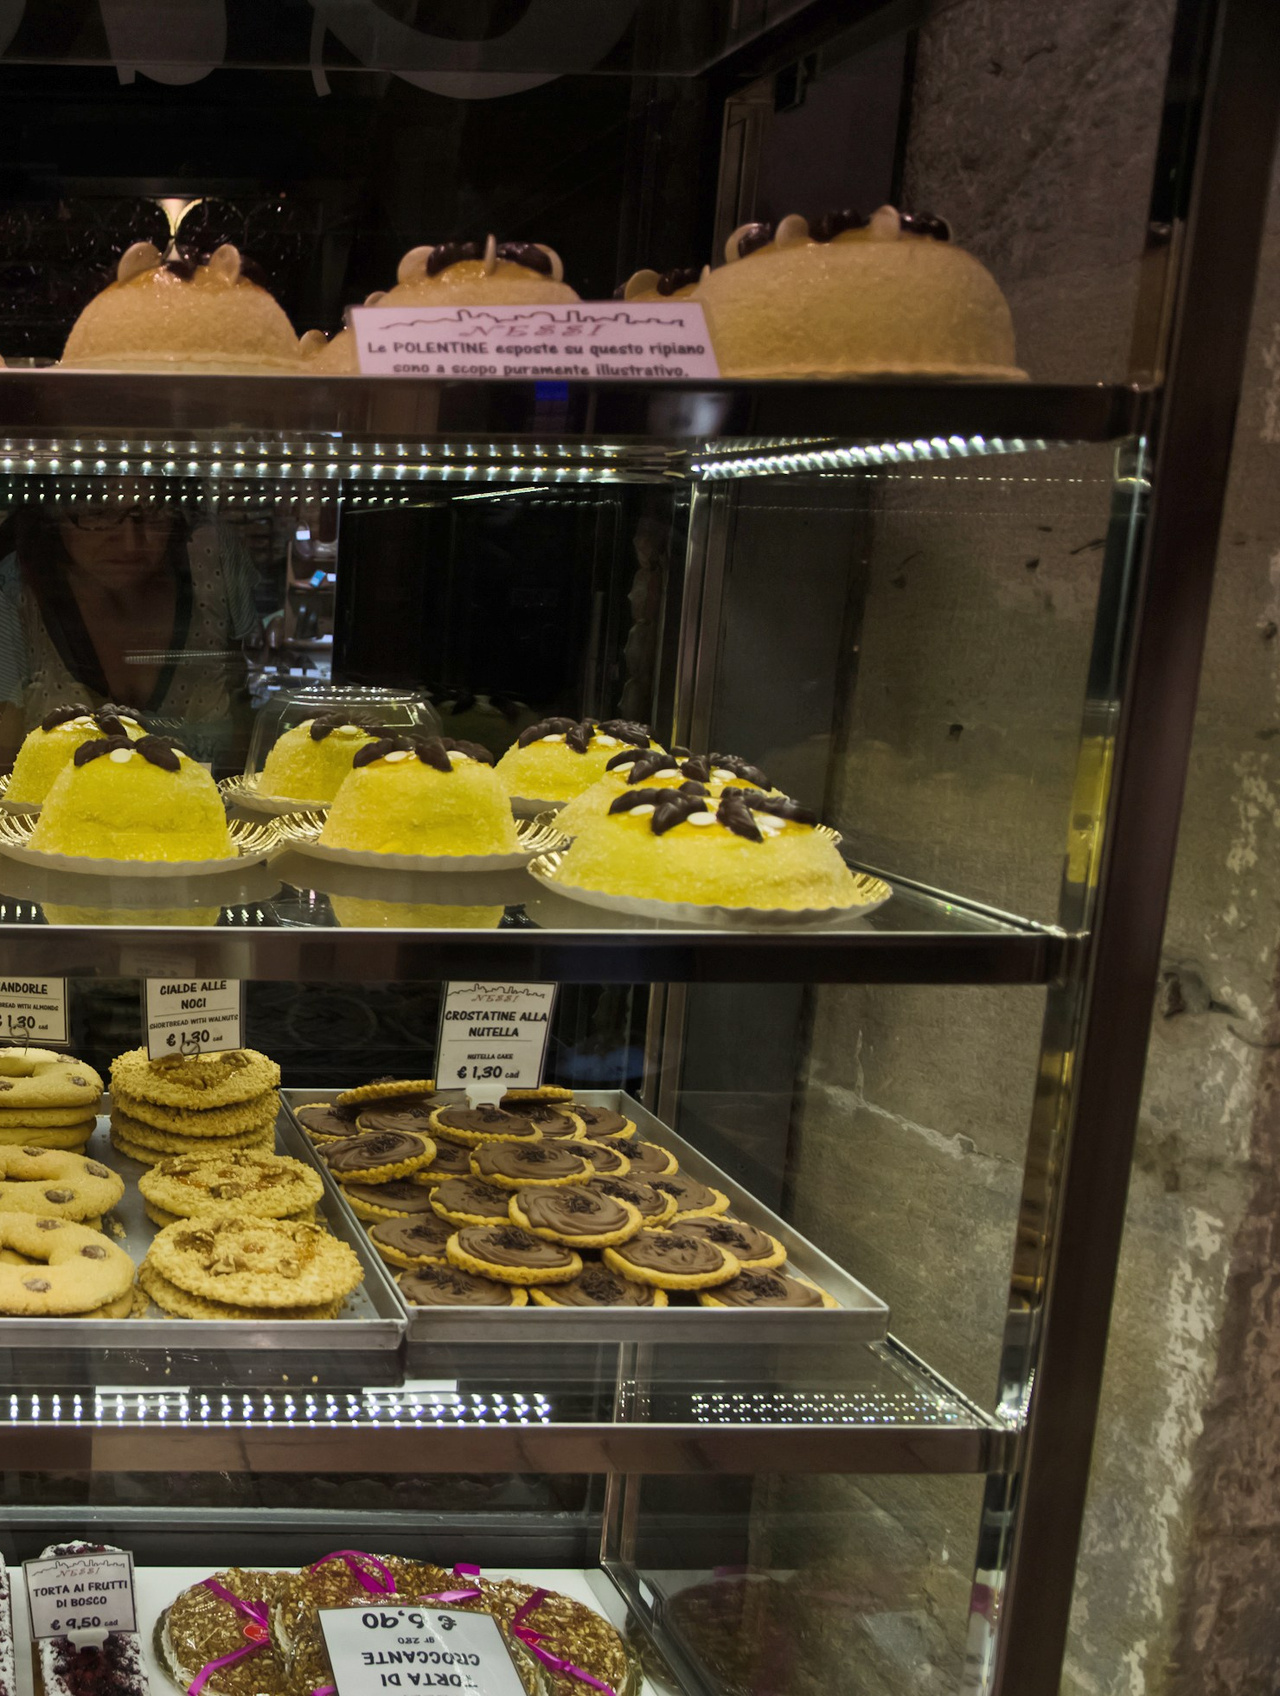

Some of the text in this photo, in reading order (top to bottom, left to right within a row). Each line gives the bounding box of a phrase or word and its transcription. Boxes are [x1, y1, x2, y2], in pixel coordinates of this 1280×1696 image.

[459, 324, 605, 337] NESSI
[368, 342, 705, 358] Le POLENTINE esposte su questo ripiano
[393, 364, 689, 377] sono a scopo puramente illustrativo.
[159, 980, 227, 995] CIALDE ALLE
[181, 998, 206, 1009] NOCI
[7, 1015, 36, 1029] 1,30
[149, 1020, 189, 1030] SHORTBREAD
[208, 1014, 239, 1022] WALNUTS
[445, 1011, 548, 1022] CROSTATINE ALLA
[166, 1033, 176, 1047] €
[181, 1029, 210, 1046] 1,30
[468, 1027, 519, 1037] NUTELLA
[457, 1065, 520, 1080] € 1,30 cad
[33, 1580, 128, 1597] TORTA AI FRUTTI
[56, 1596, 107, 1608] DI BOSCO
[50, 1616, 118, 1631] € 9,50 cad
[437, 1615, 458, 1631] €
[397, 1636, 435, 1645] gr 280
[361, 1651, 480, 1666] CROCCANTE
[380, 1672, 402, 1687] DI
